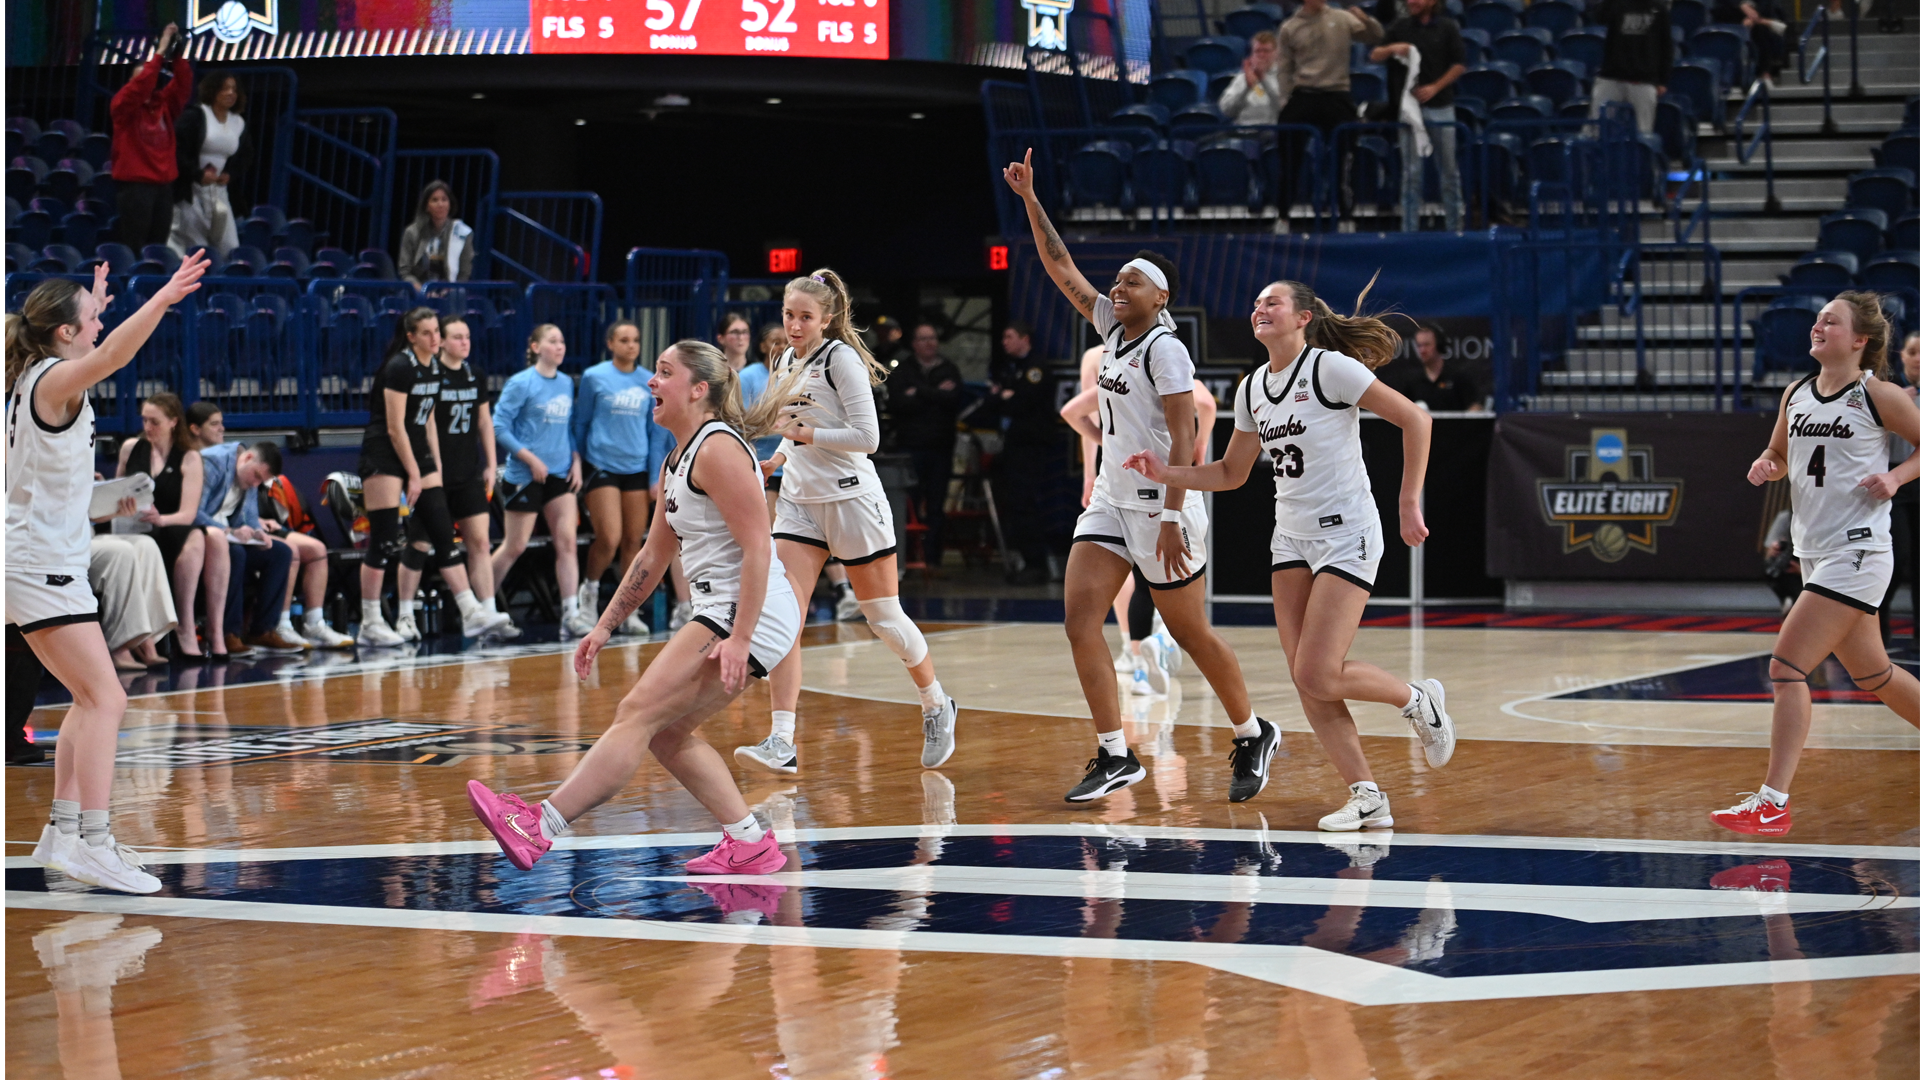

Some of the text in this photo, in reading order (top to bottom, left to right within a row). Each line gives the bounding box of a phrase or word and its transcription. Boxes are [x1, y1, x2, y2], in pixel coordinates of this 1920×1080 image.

[542, 16, 614, 38] FLS 5
[645, 0, 701, 30] 57
[740, 0, 798, 33] 52
[649, 34, 697, 49] BONUS
[745, 35, 789, 51] BONUS
[818, 20, 877, 44] FLS 5
[769, 248, 798, 273] EXIT
[448, 402, 473, 434] 25
[1106, 397, 1115, 436] 1
[1257, 414, 1307, 443] Hawks
[1789, 413, 1854, 439] Hawks
[1269, 443, 1305, 478] 23
[1807, 445, 1826, 487] 4
[1554, 491, 1669, 514] ELITE EIGHT
